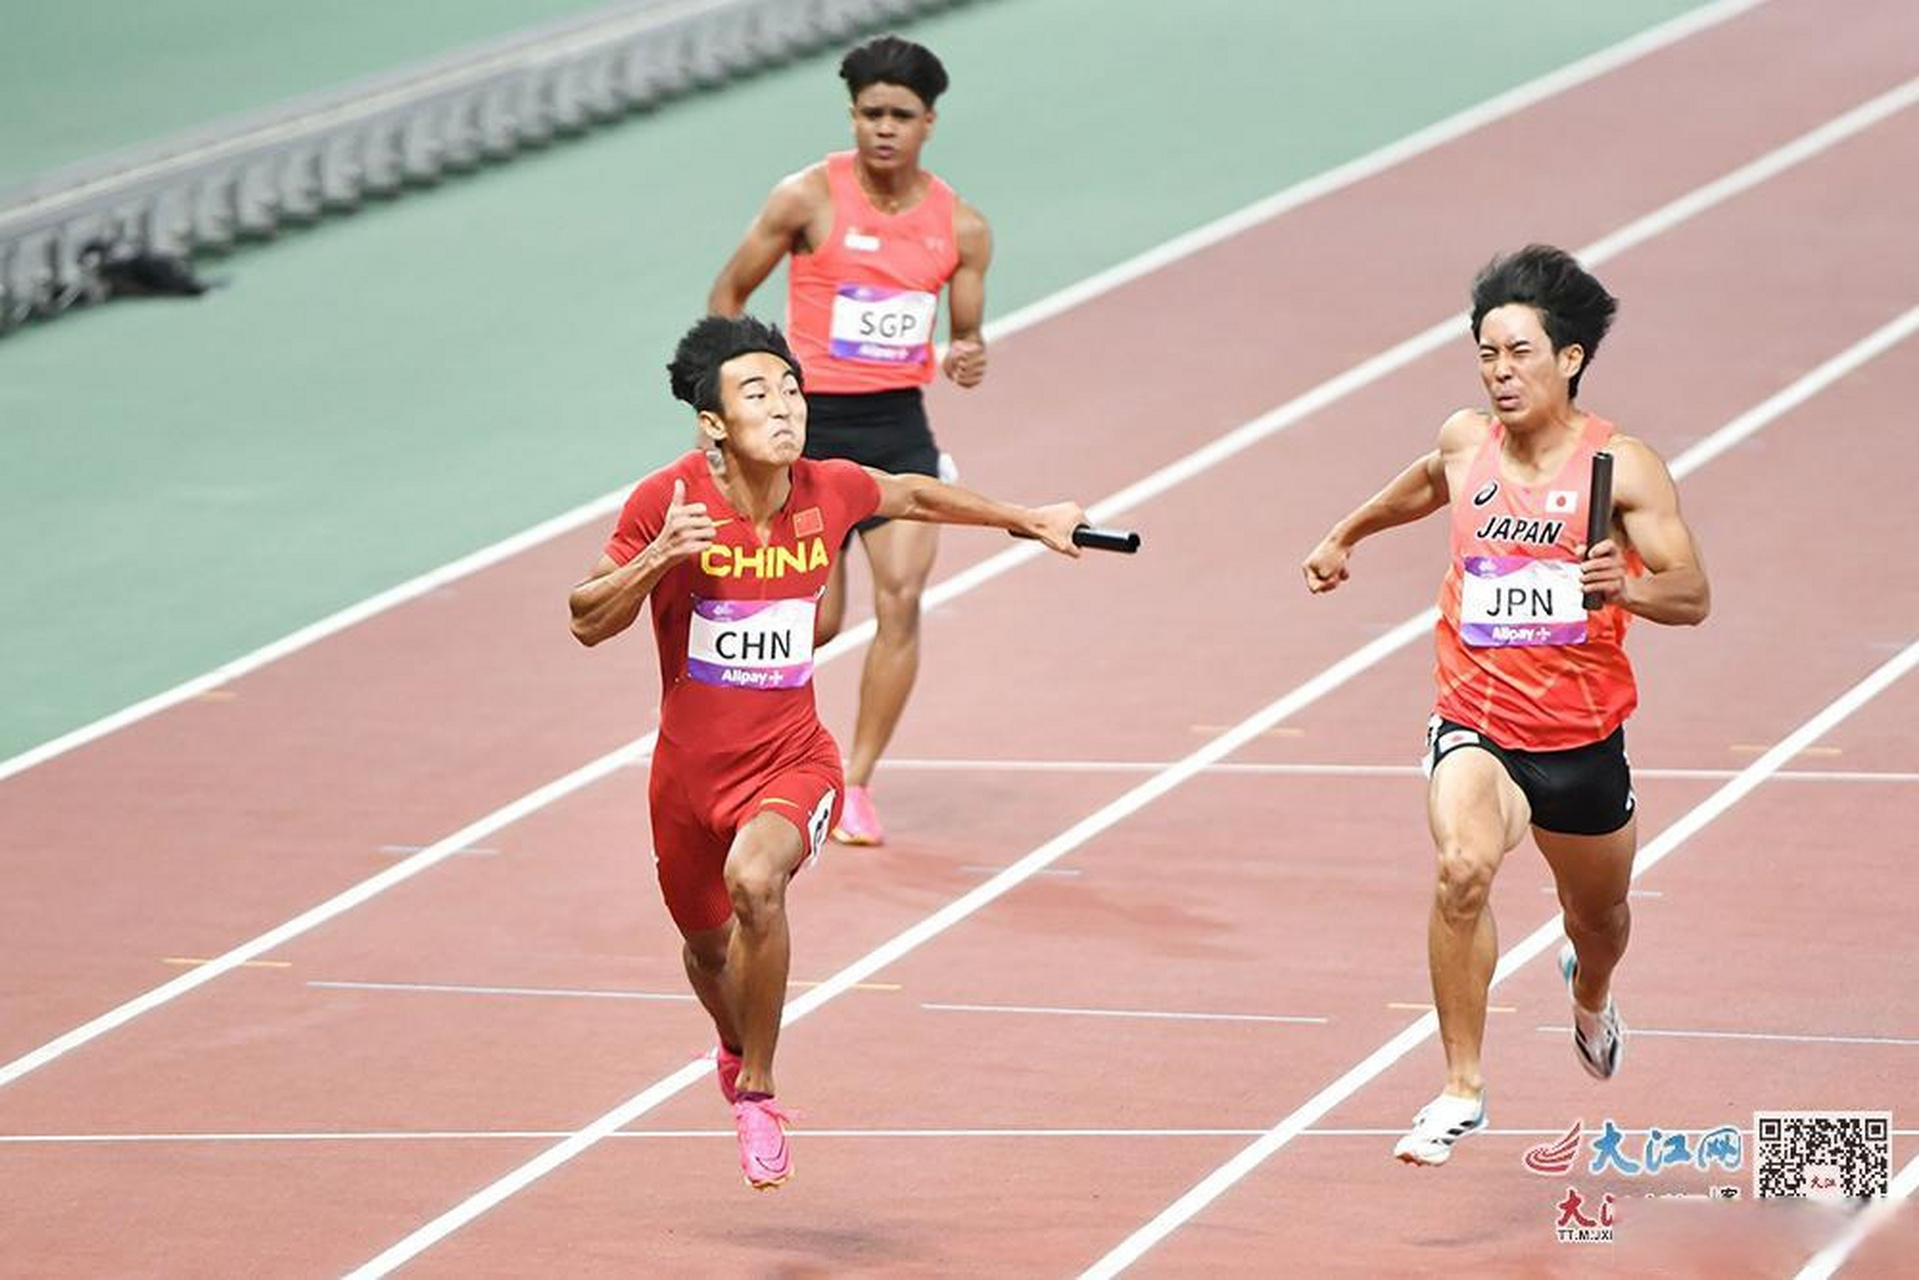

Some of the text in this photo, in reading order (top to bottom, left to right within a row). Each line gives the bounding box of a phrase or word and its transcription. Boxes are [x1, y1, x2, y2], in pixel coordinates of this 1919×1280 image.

[859, 310, 917, 338] SGP
[1476, 515, 1563, 545] JAPAN
[701, 537, 829, 579] CHINA
[1486, 587, 1553, 617] JPN
[715, 629, 791, 660] CHN
